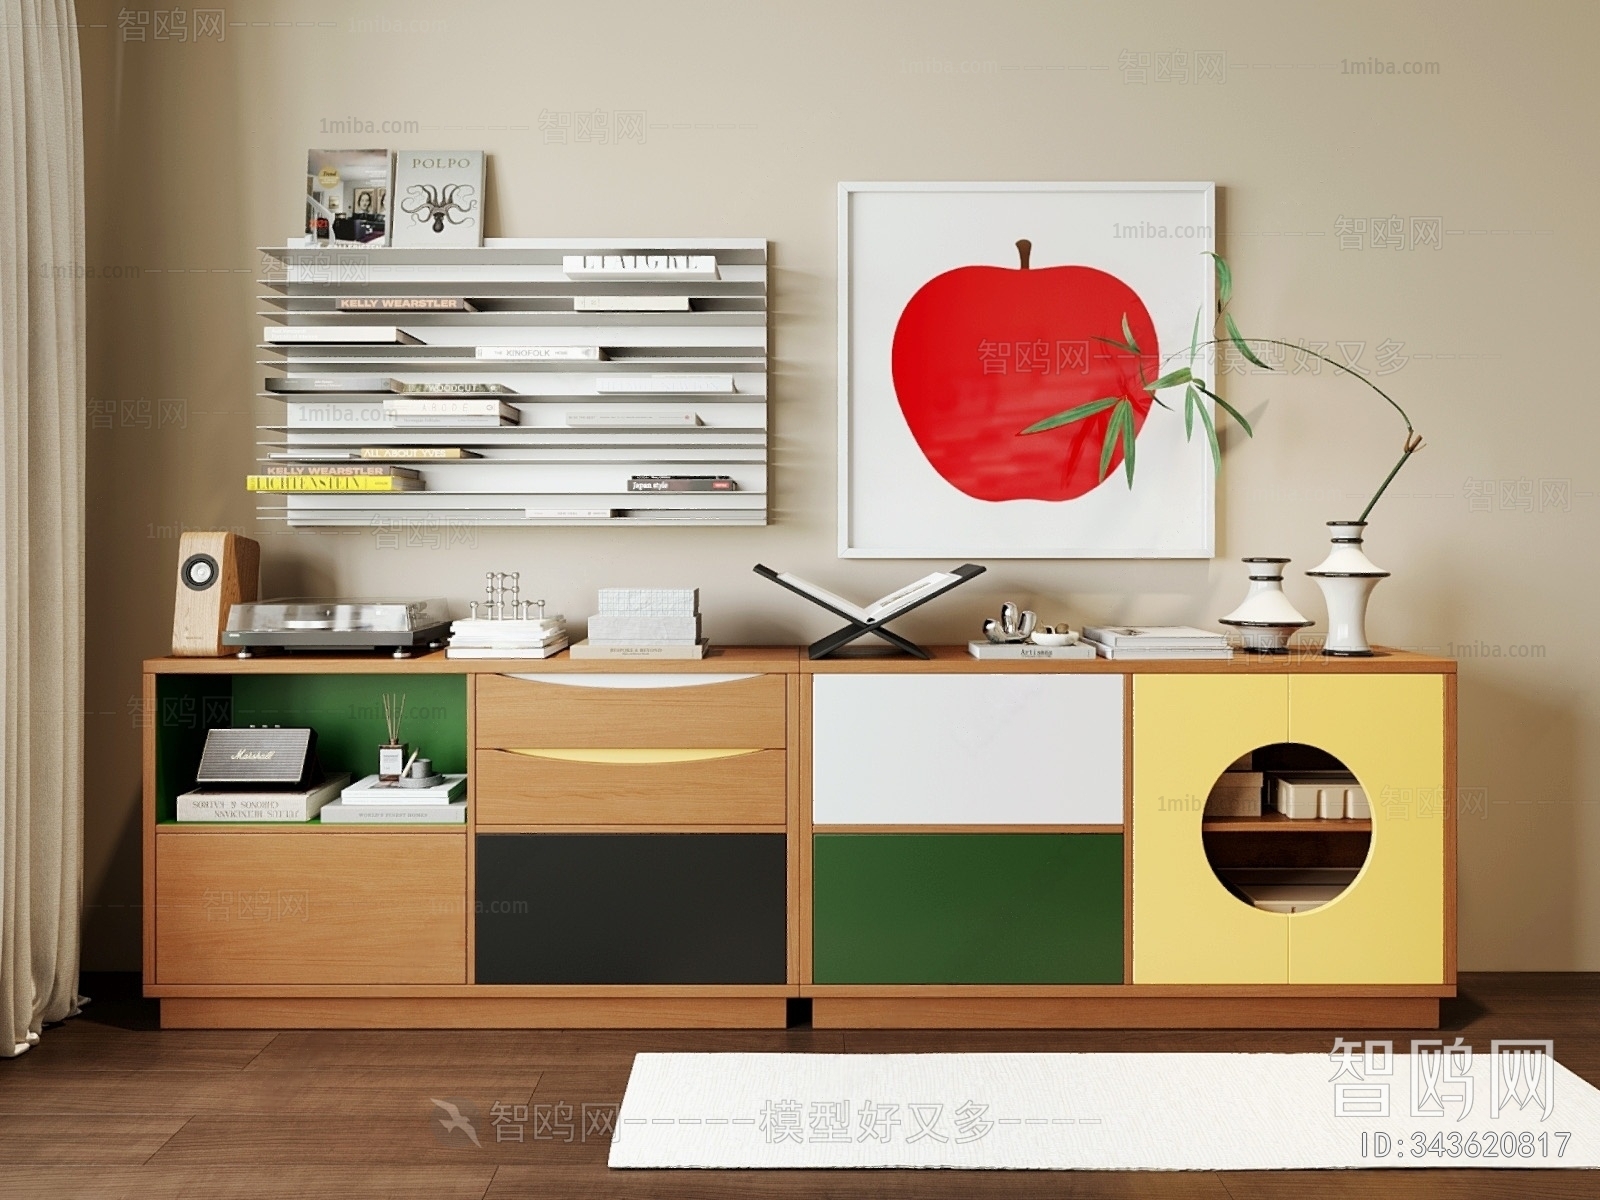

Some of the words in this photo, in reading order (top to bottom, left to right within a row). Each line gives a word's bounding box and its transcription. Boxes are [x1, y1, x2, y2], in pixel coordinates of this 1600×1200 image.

[412, 158, 470, 169] POLPO
[341, 299, 377, 308] KELLY
[382, 299, 457, 308] WEARSTLER
[428, 384, 477, 392] WOODCUT
[421, 403, 469, 412] ABODE
[364, 449, 378, 457] ALL
[384, 449, 417, 457] ABOUT
[422, 449, 446, 457] YVES
[267, 467, 305, 475] KELLY
[308, 467, 383, 475] WEARSTLER
[653, 482, 669, 490] style
[231, 749, 275, 760] Marshall
